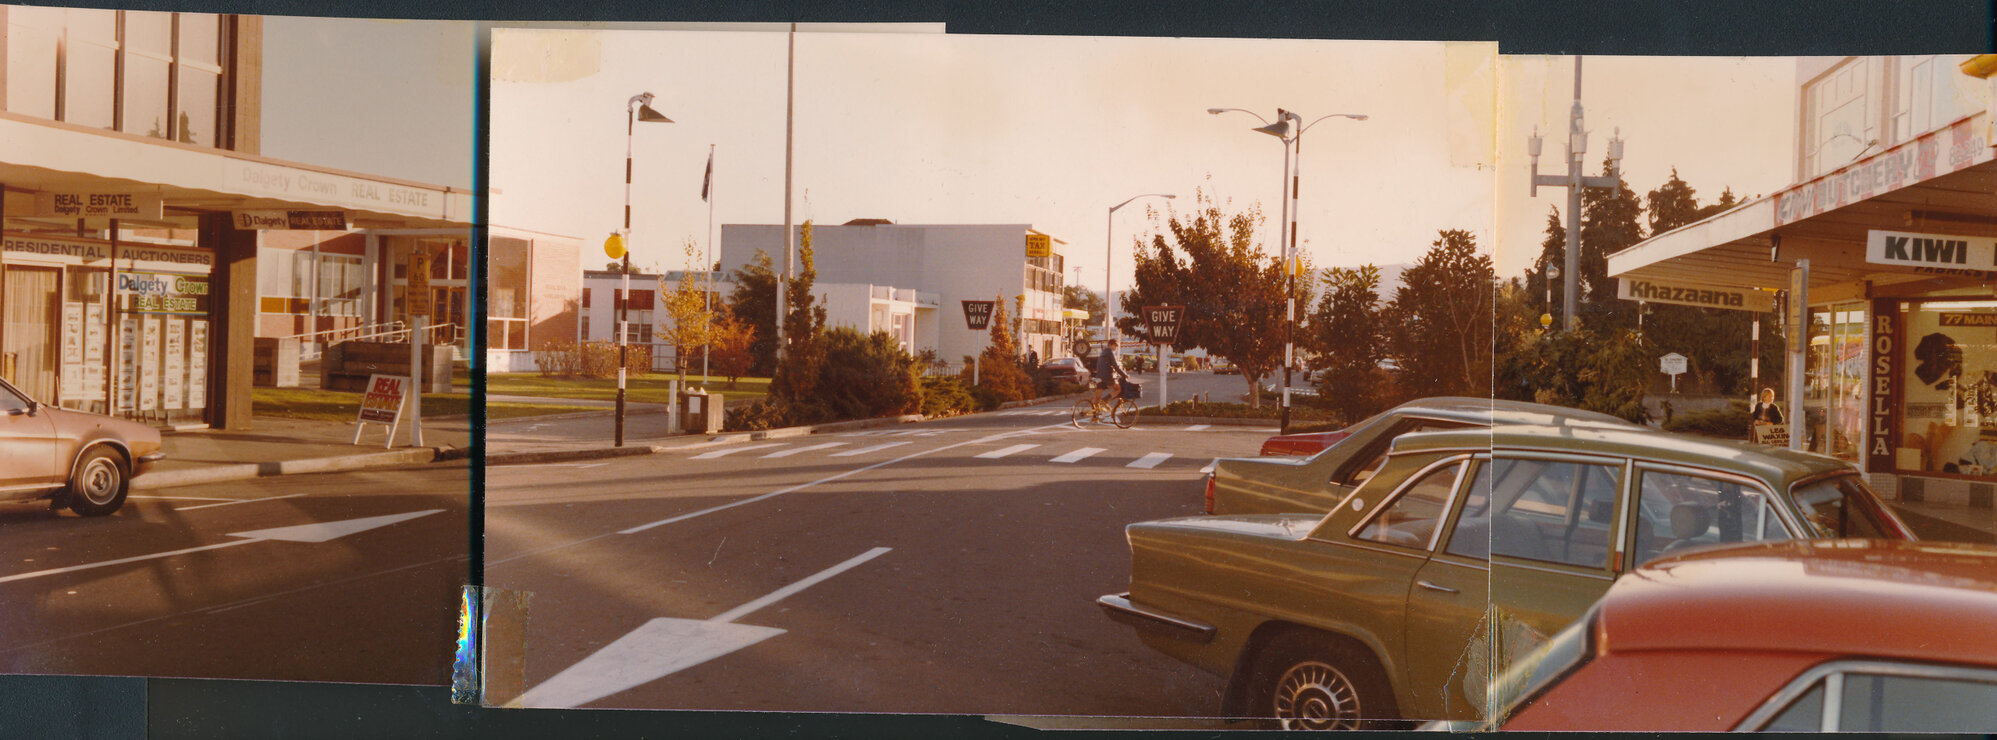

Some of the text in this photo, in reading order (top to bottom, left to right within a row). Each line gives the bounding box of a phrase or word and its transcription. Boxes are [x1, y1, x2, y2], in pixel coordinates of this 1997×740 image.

[1817, 148, 1914, 208] BUTCHERY
[242, 167, 429, 207] Dalgety Crown REAL ESTATE
[54, 194, 132, 206] REAL ESTATE
[54, 205, 81, 216] Dalgety
[86, 205, 109, 214] Crown
[253, 215, 287, 229] Dalgety
[290, 216, 309, 227] REAL
[5, 240, 211, 265] RESIDENTIAL AUCTIONEERS
[1884, 236, 1968, 264] KIWI
[417, 257, 424, 269] P
[118, 274, 168, 298] Dalgety
[1629, 280, 1744, 307] Khazaana
[135, 297, 197, 311] REAL ESTATE
[968, 303, 988, 313] GIVE
[970, 315, 987, 325] WAY
[1151, 310, 1176, 322] GIVE
[1153, 325, 1175, 337] WAY
[373, 377, 402, 394] REAL
[1871, 315, 1894, 456] ROSELLA
[363, 391, 403, 411] ESTATE
